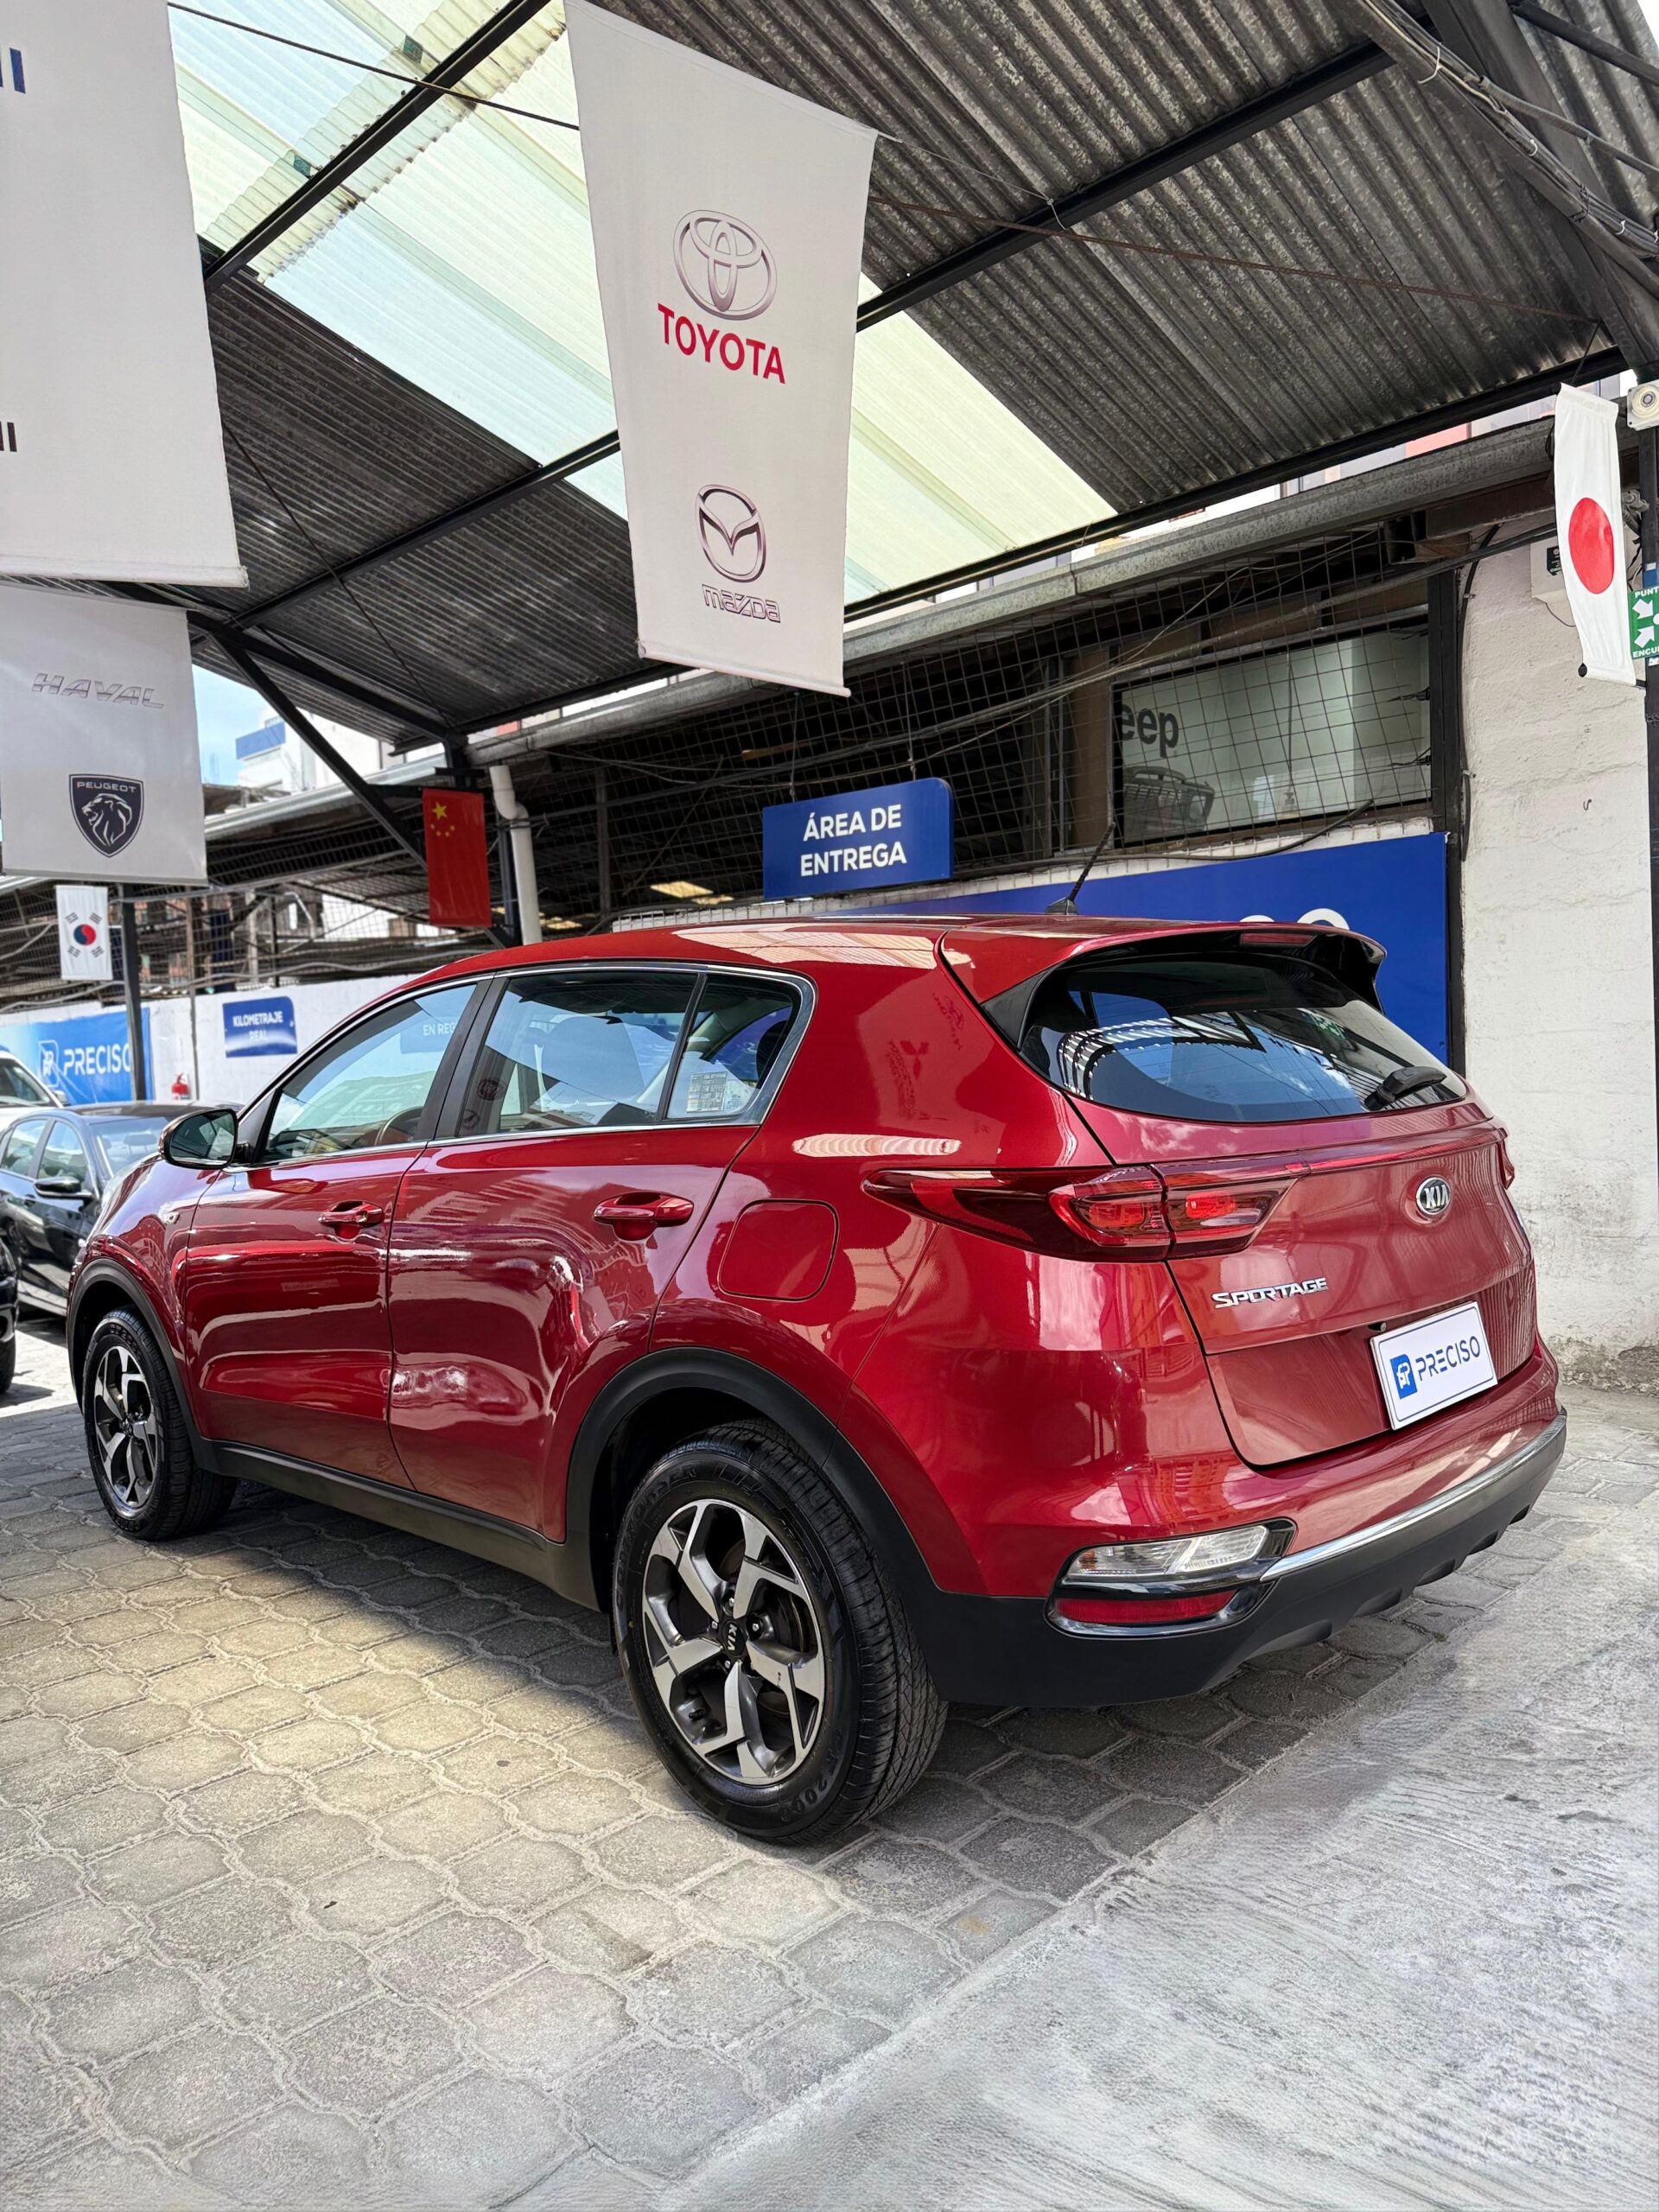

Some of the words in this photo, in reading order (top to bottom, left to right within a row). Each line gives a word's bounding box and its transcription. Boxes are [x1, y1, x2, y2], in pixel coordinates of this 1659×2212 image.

[658, 302, 785, 385] TOYOTA
[1632, 645, 1659, 658] ENCU
[31, 672, 164, 709] HAVAL
[1122, 704, 1179, 759] eep
[76, 781, 137, 793] PEUGEOT
[803, 811, 867, 842] ÁREA
[870, 804, 901, 831] DE
[800, 841, 907, 877] ENTREGA
[232, 1011, 283, 1027] KILOMETRAJE
[423, 1024, 436, 1036] EN
[1424, 1184, 1448, 1209] KIA
[1211, 1277, 1329, 1309] SPORTAGE
[1415, 1336, 1480, 1382] PRECISO
[728, 1624, 738, 1651] KIA
